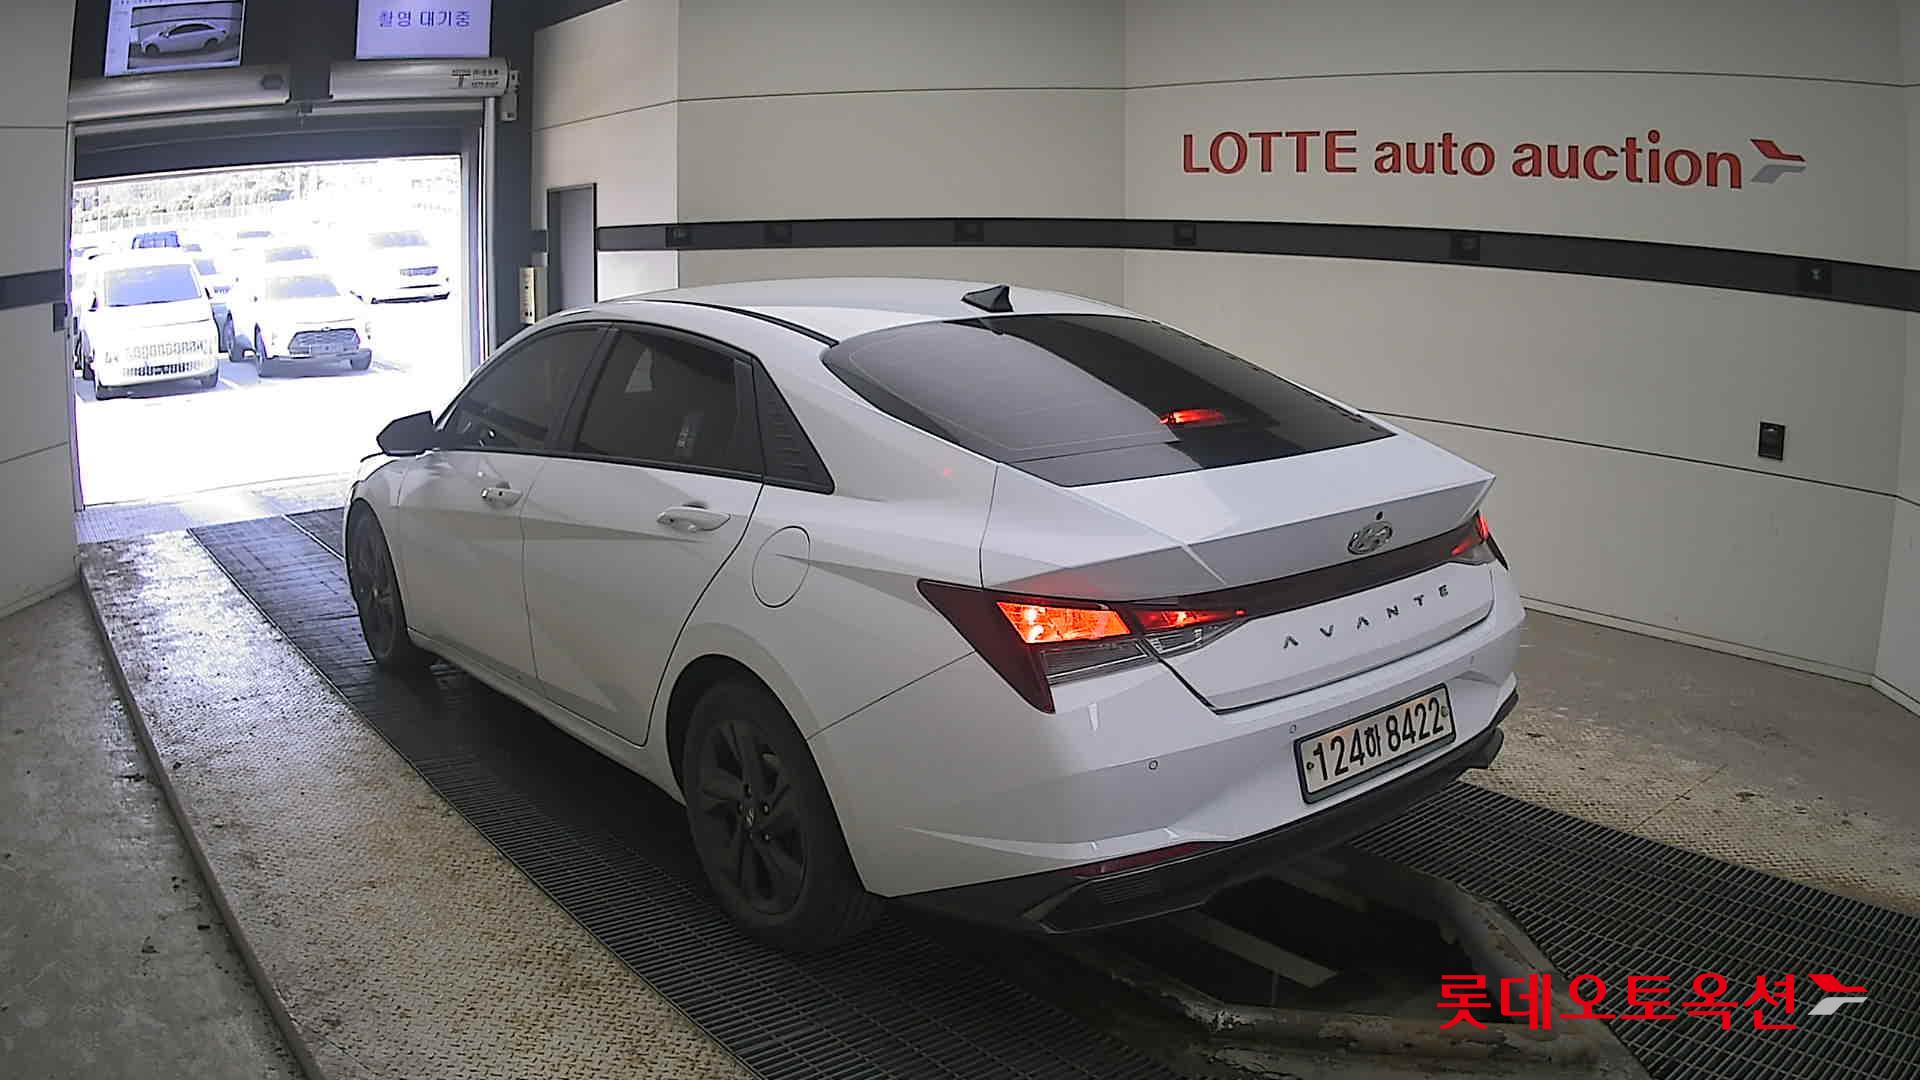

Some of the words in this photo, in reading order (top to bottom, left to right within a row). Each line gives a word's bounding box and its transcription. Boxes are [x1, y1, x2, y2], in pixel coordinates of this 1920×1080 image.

[419, 9, 470, 28] 대기중
[1183, 130, 1357, 174] LOTTE
[1374, 132, 1496, 177] auto
[1512, 128, 1743, 189] auction
[1282, 583, 1450, 650] AVANTE
[1312, 725, 1382, 782] 124하
[1386, 696, 1446, 753] 8422
